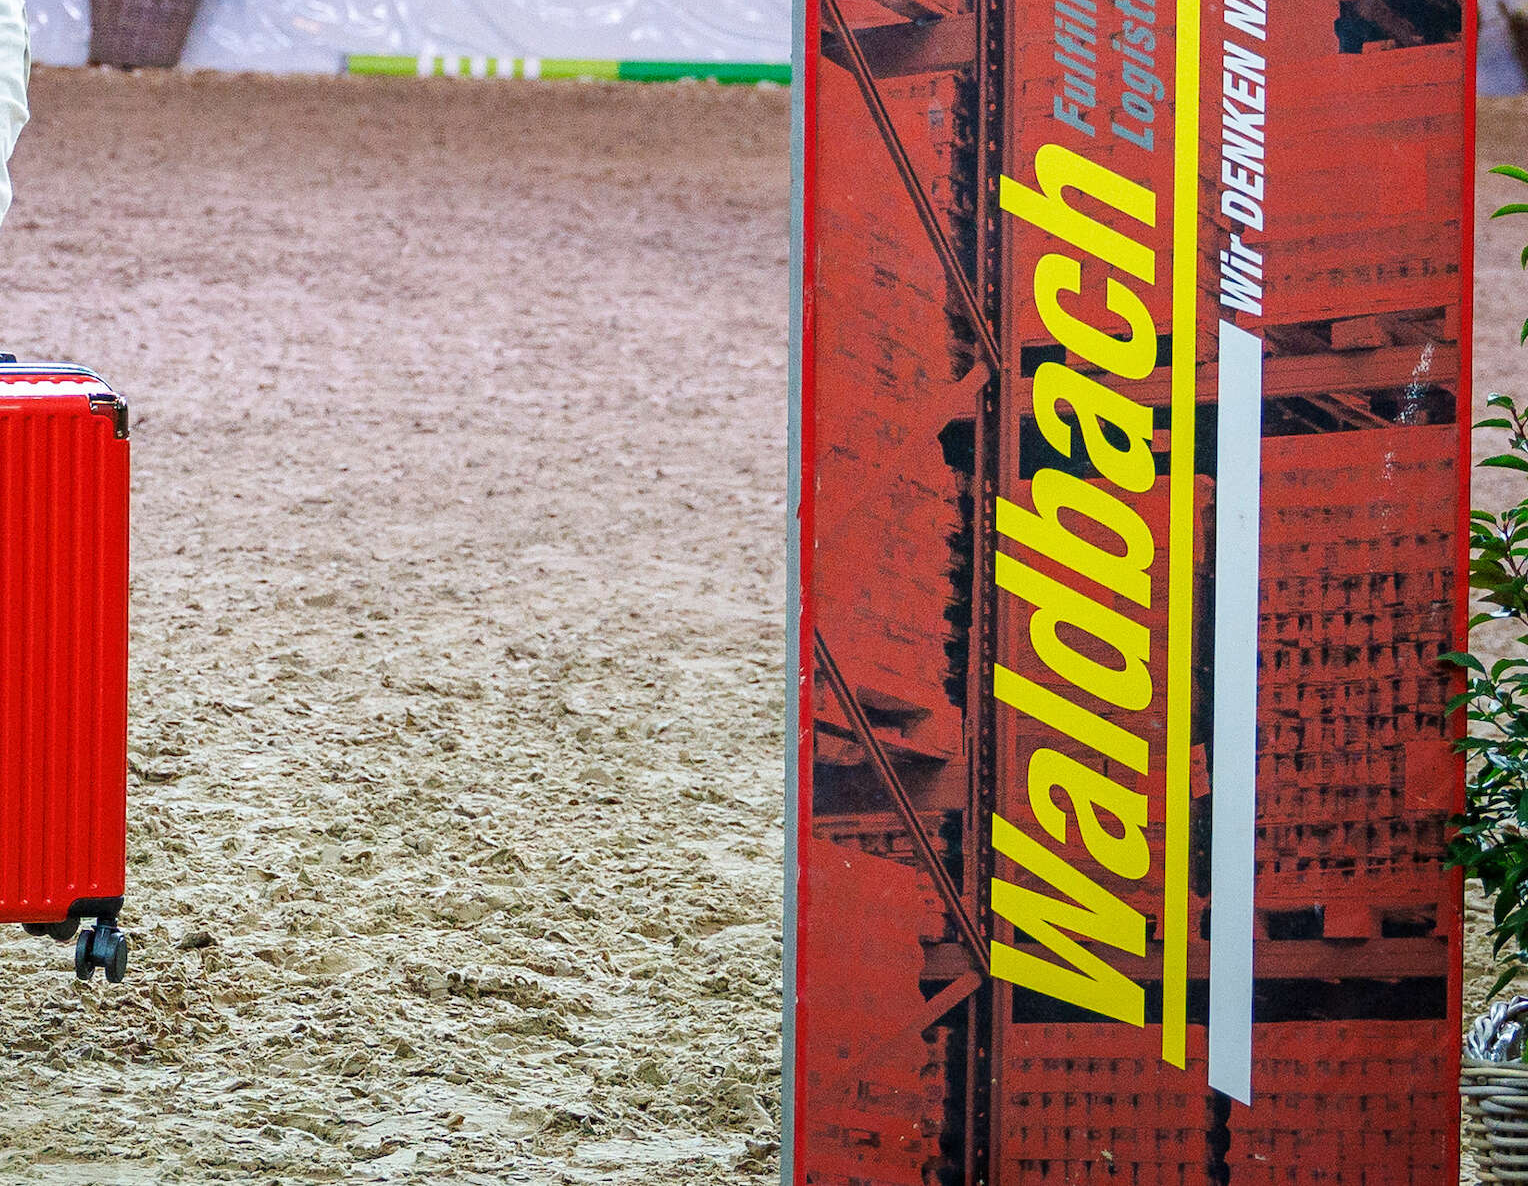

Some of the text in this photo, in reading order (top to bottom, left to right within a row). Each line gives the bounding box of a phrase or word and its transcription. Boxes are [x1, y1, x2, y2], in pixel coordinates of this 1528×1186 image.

[1221, 41, 1265, 232] DENKEN
[1220, 232, 1263, 317] Wir
[990, 142, 1160, 1028] Waldbach
